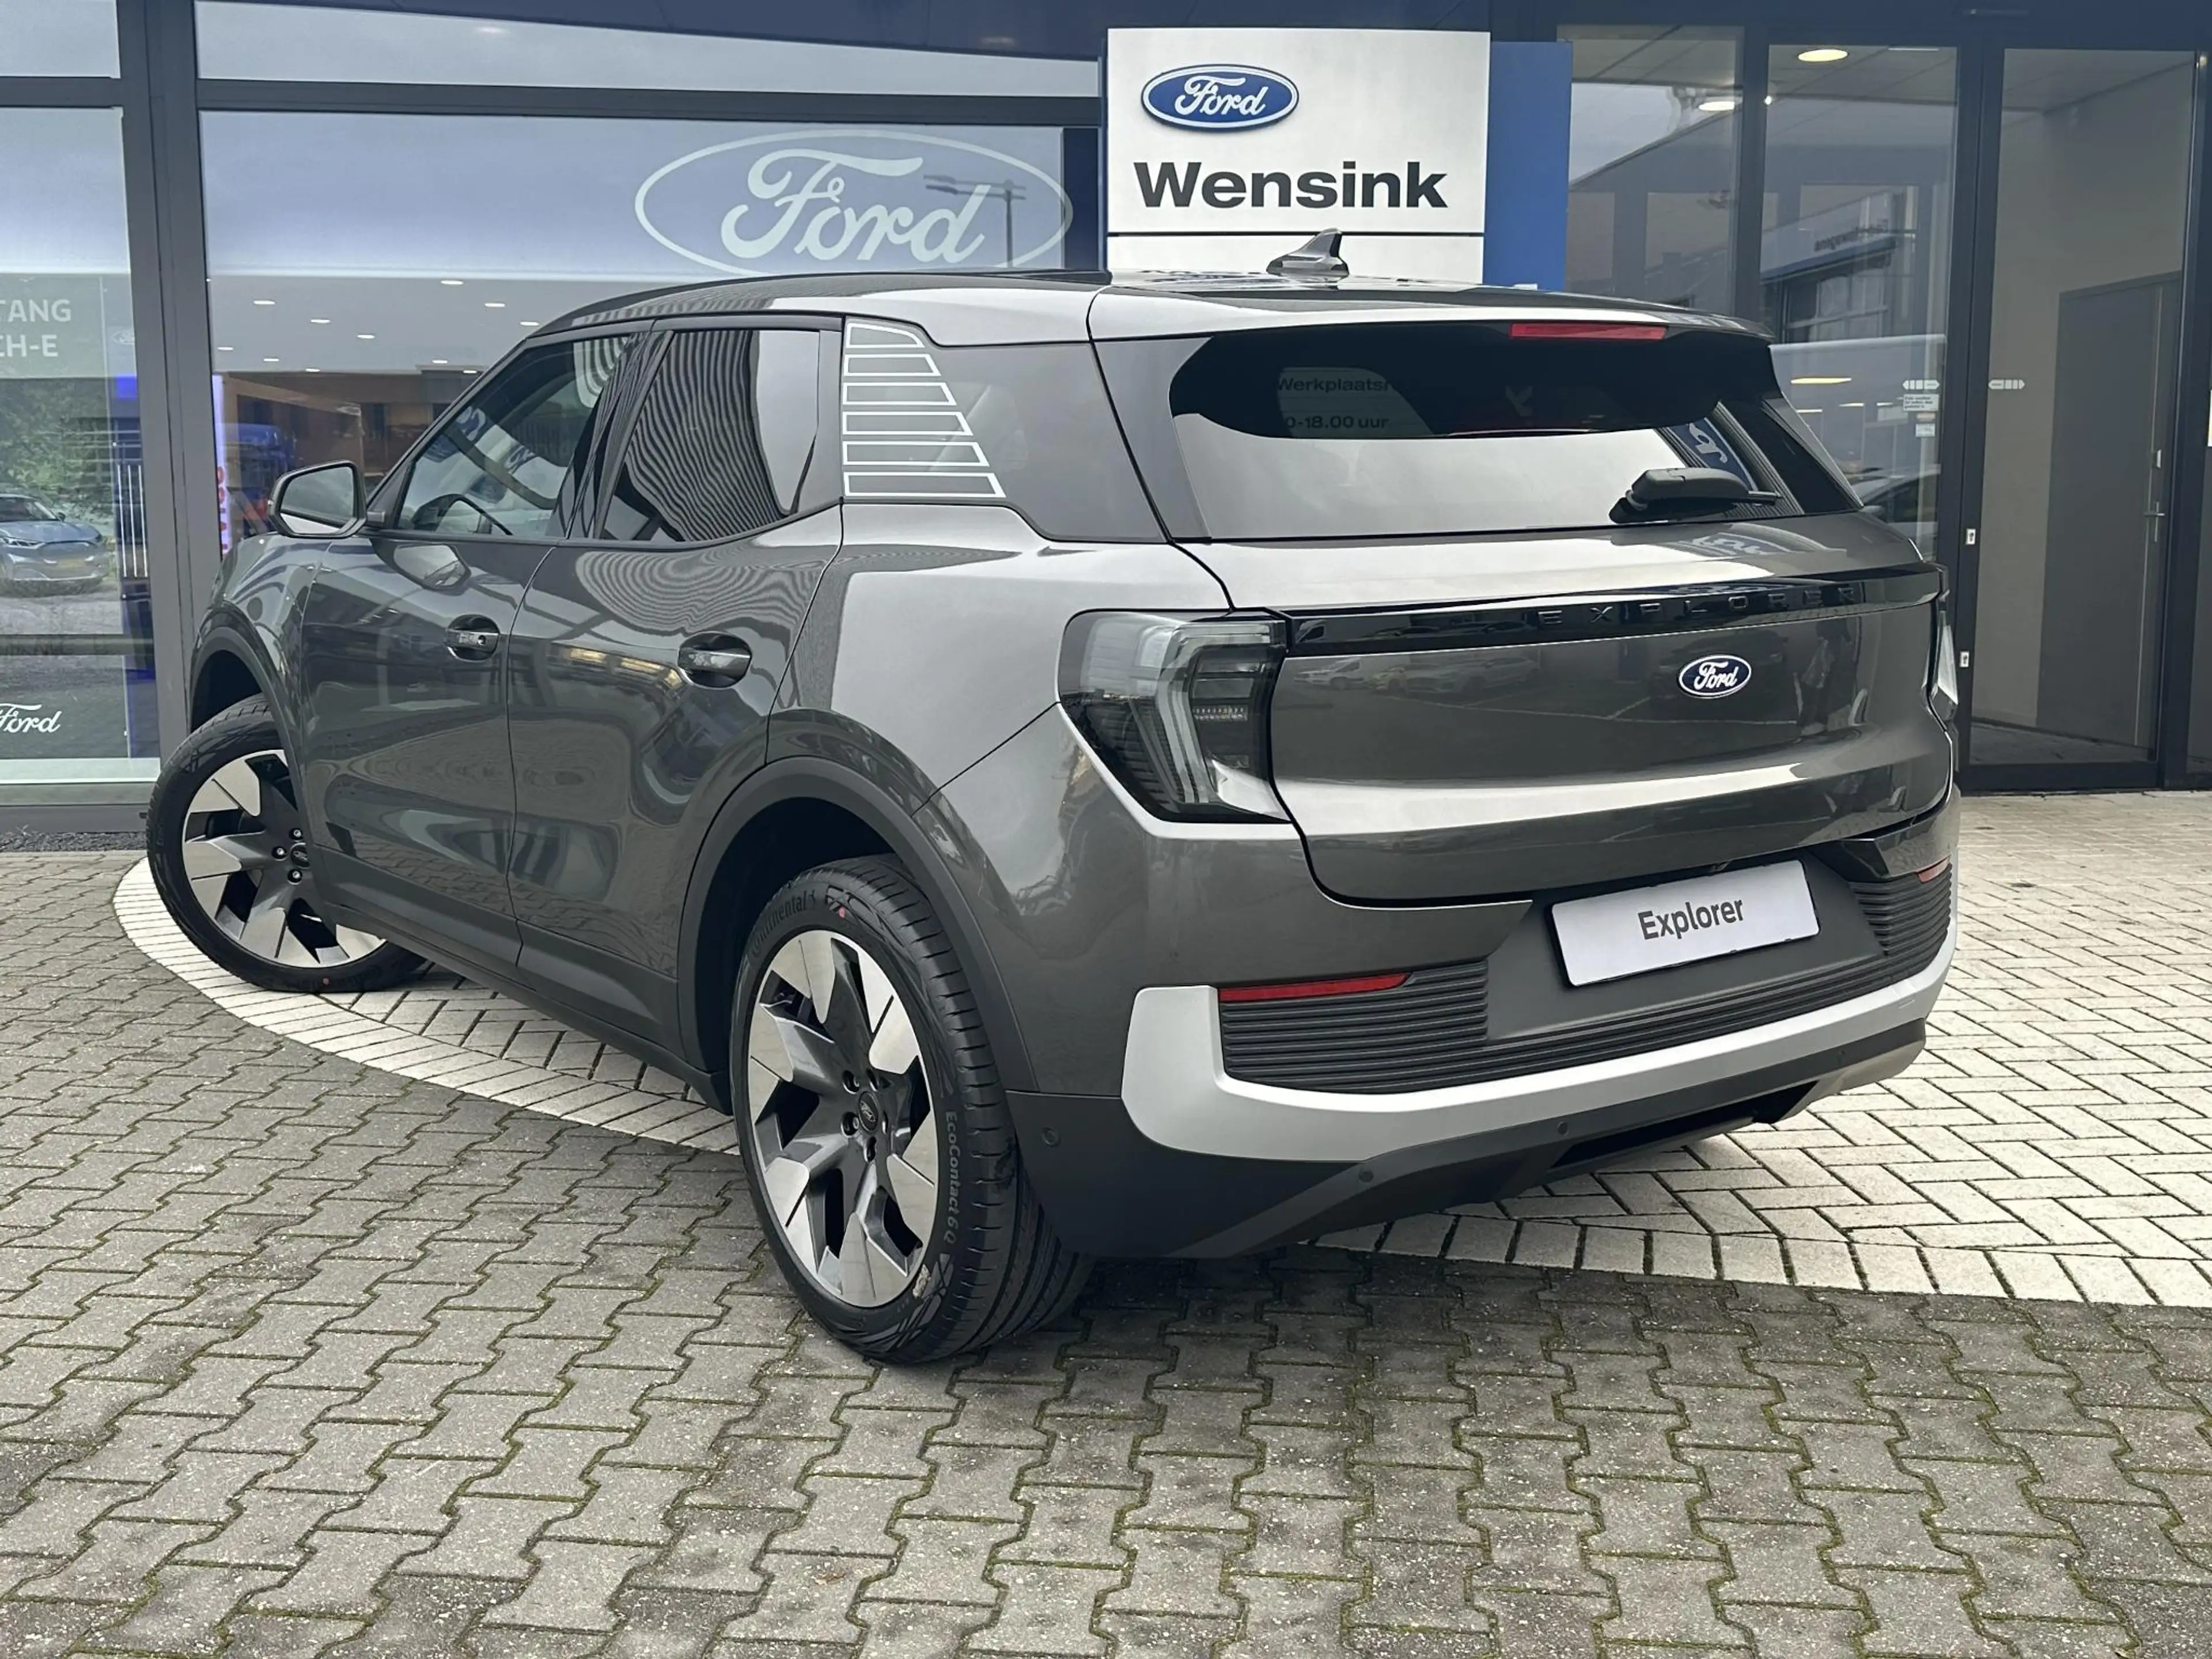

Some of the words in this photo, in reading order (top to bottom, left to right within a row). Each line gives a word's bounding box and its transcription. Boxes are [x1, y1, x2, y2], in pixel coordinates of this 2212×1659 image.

[1174, 75, 1269, 116] Ford
[721, 148, 992, 264] Ford
[1133, 161, 1448, 210] Wensink
[1357, 416, 1390, 429] uur
[1537, 586, 1857, 626] EXPLORER
[1694, 661, 1739, 690] Ford
[1637, 898, 1744, 940] Explorer
[945, 1110, 961, 1213] EcoContact
